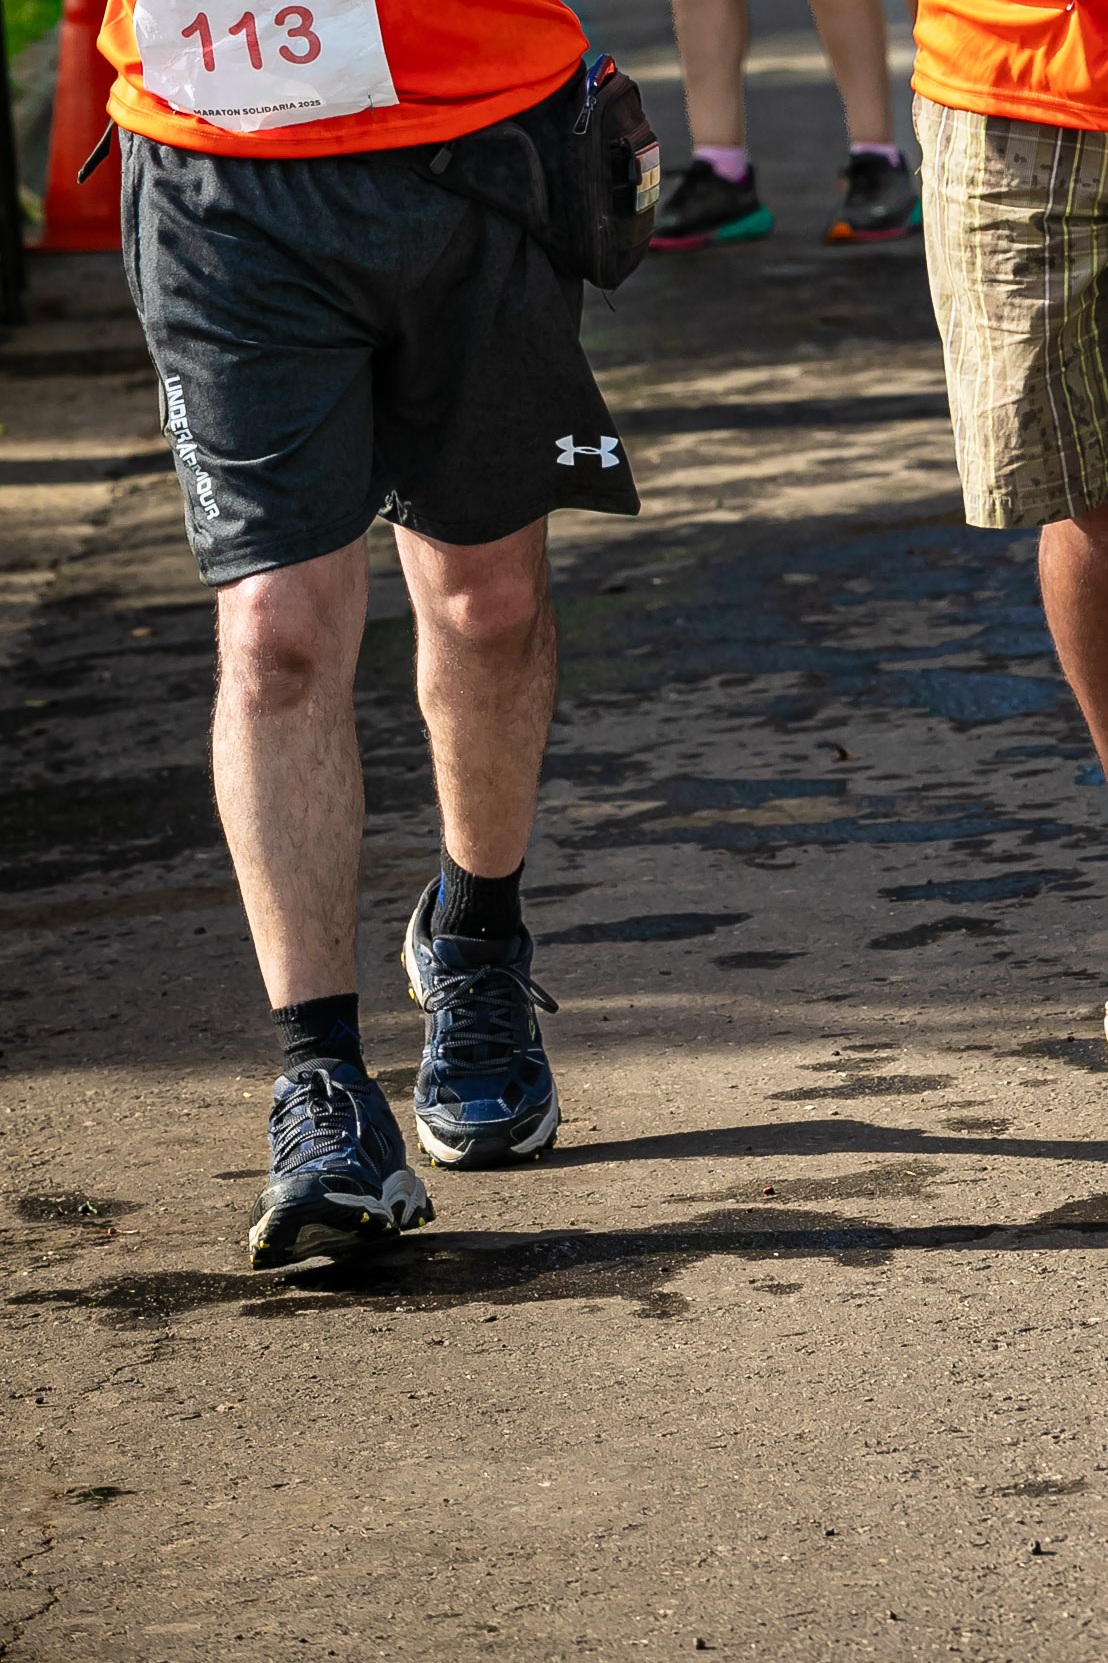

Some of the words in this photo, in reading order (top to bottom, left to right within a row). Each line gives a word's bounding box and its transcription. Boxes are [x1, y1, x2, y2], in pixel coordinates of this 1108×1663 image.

[181, 5, 322, 73] 113
[193, 108, 241, 117] MARATON
[242, 102, 297, 116] SOLIDARIA
[297, 99, 322, 108] 2025
